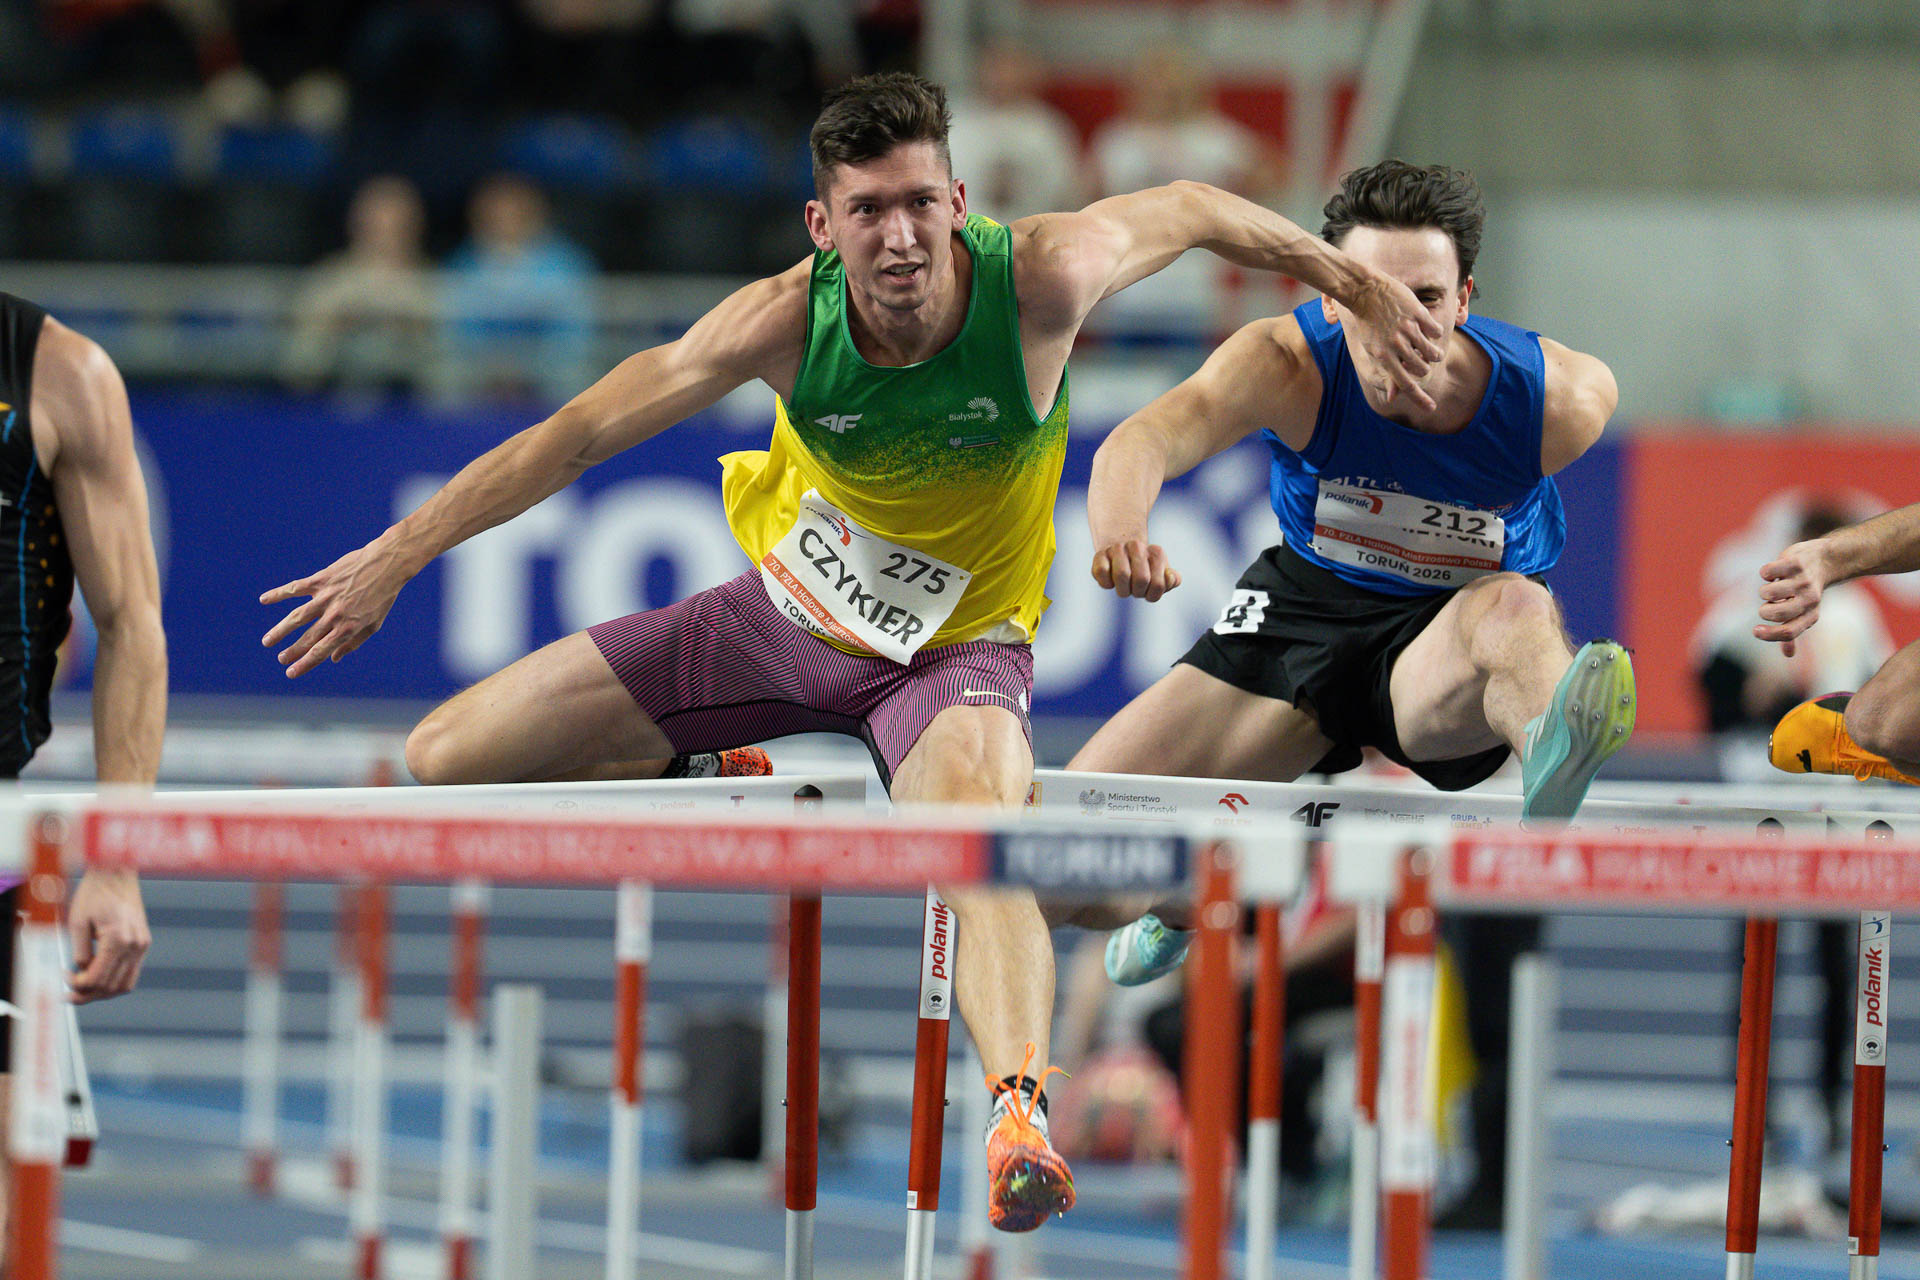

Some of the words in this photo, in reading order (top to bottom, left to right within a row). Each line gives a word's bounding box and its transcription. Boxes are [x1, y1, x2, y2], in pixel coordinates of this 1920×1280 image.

[814, 413, 863, 434] 4F
[1324, 491, 1370, 509] polanik
[1421, 504, 1487, 537] 212
[1339, 530, 1362, 544] PZLA
[1364, 539, 1400, 556] Halowe
[1401, 550, 1461, 566] Mistrzostwa
[1463, 558, 1493, 569] Polski
[1356, 550, 1410, 574] TORUŃ
[1413, 567, 1452, 580] 2026
[799, 528, 924, 646] CZYKIER
[879, 552, 951, 595] 275
[769, 558, 781, 575] 70.
[780, 571, 798, 592] PZLA
[796, 588, 826, 619] Halowe
[823, 615, 868, 651] Mistrzost
[1107, 802, 1134, 814] Sportu
[1140, 804, 1178, 815] Turystyki
[1108, 792, 1161, 804] Ministerstwo
[1289, 801, 1342, 827] 4F
[929, 899, 949, 981] polanik
[1863, 946, 1884, 1027] polanik
